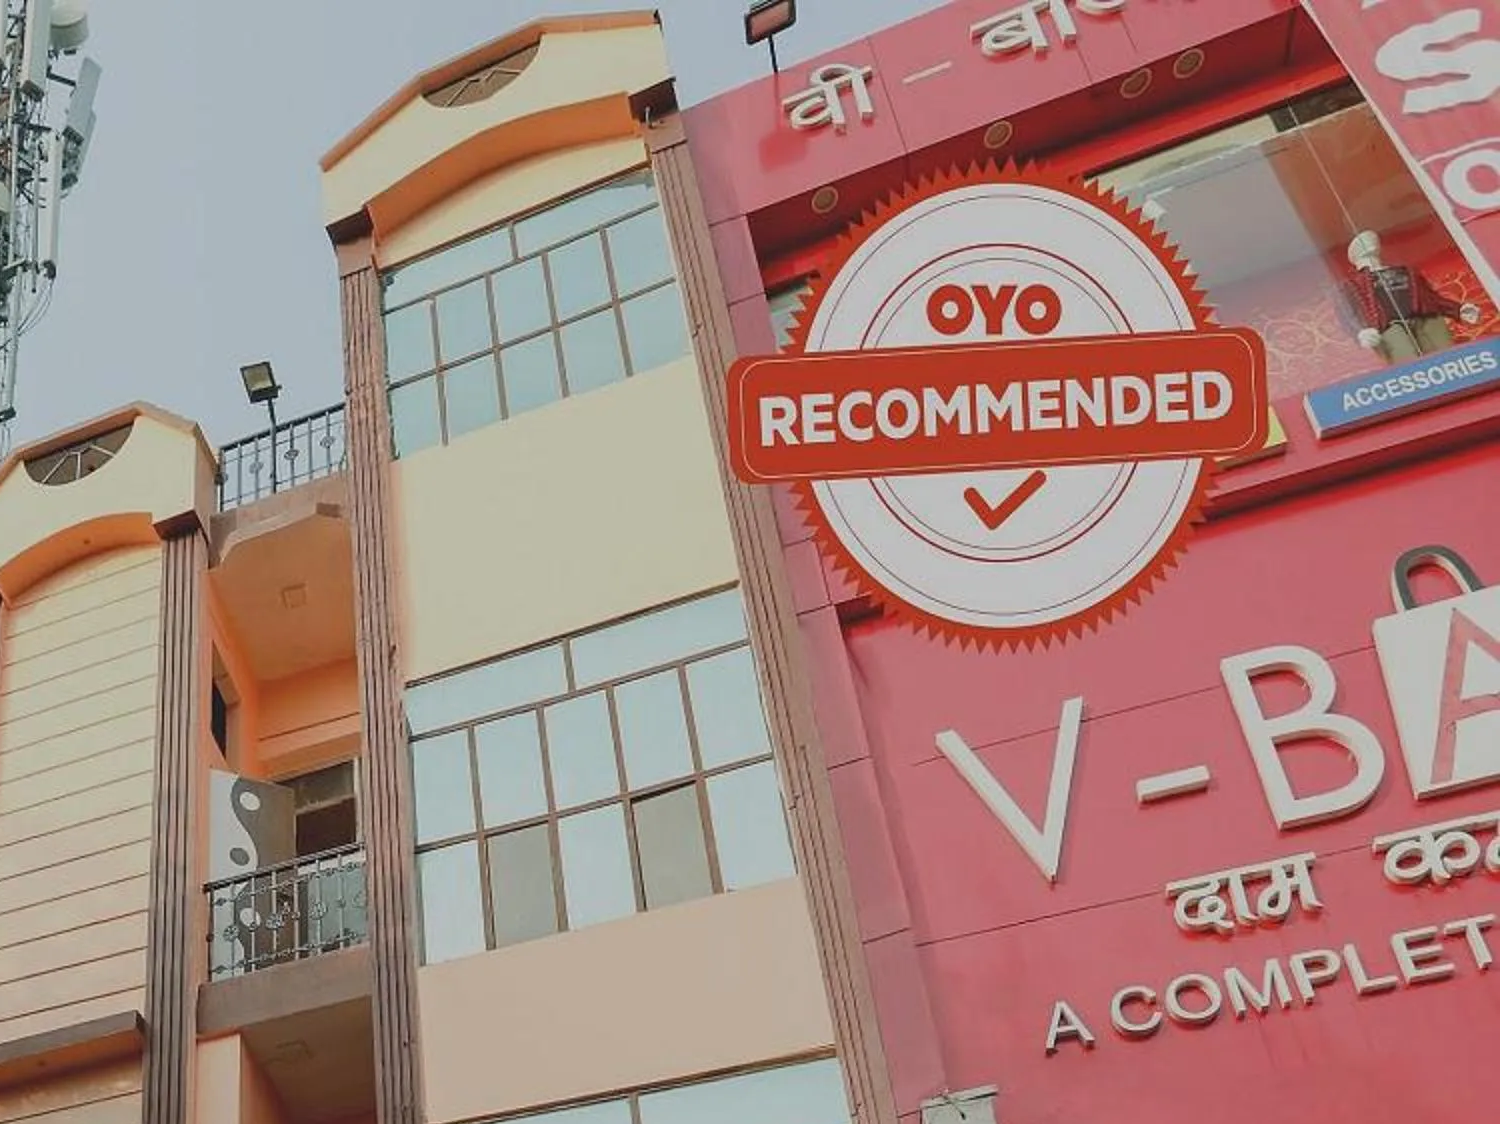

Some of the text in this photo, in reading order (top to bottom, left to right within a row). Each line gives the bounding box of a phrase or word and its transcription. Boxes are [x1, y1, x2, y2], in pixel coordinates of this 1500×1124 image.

[1342, 351, 1498, 412] ACCESSORIES
[1165, 852, 1323, 935] दाम
[1043, 913, 1497, 1055] A COMPLET
